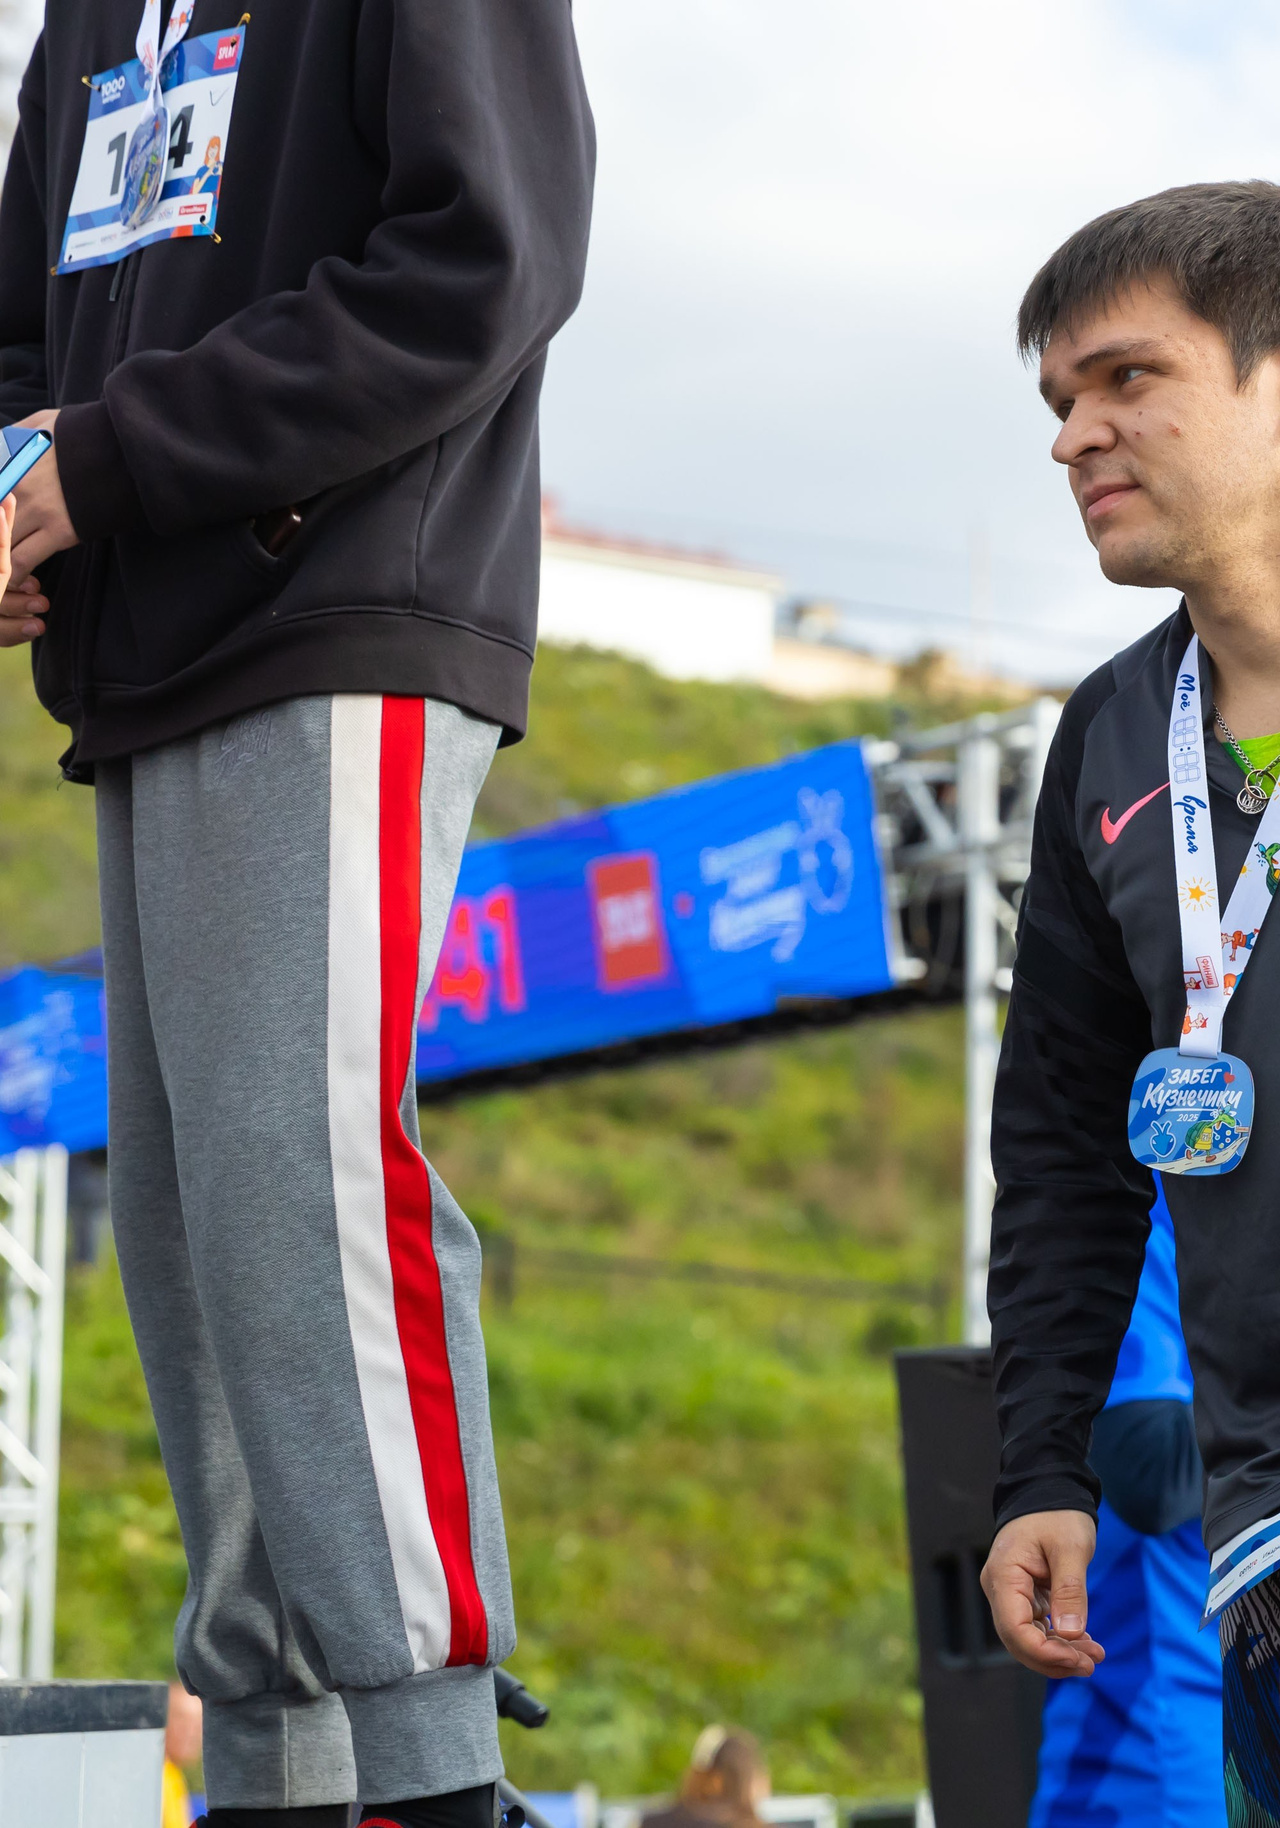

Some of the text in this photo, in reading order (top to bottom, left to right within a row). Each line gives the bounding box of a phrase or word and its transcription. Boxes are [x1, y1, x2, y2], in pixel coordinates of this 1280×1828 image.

[101, 75, 126, 98] 1000
[107, 104, 195, 197] 14
[1202, 959, 1214, 985] ФИНИШ
[1168, 1068, 1223, 1085] ЗАБЕГ
[1176, 1113, 1200, 1122] 2025
